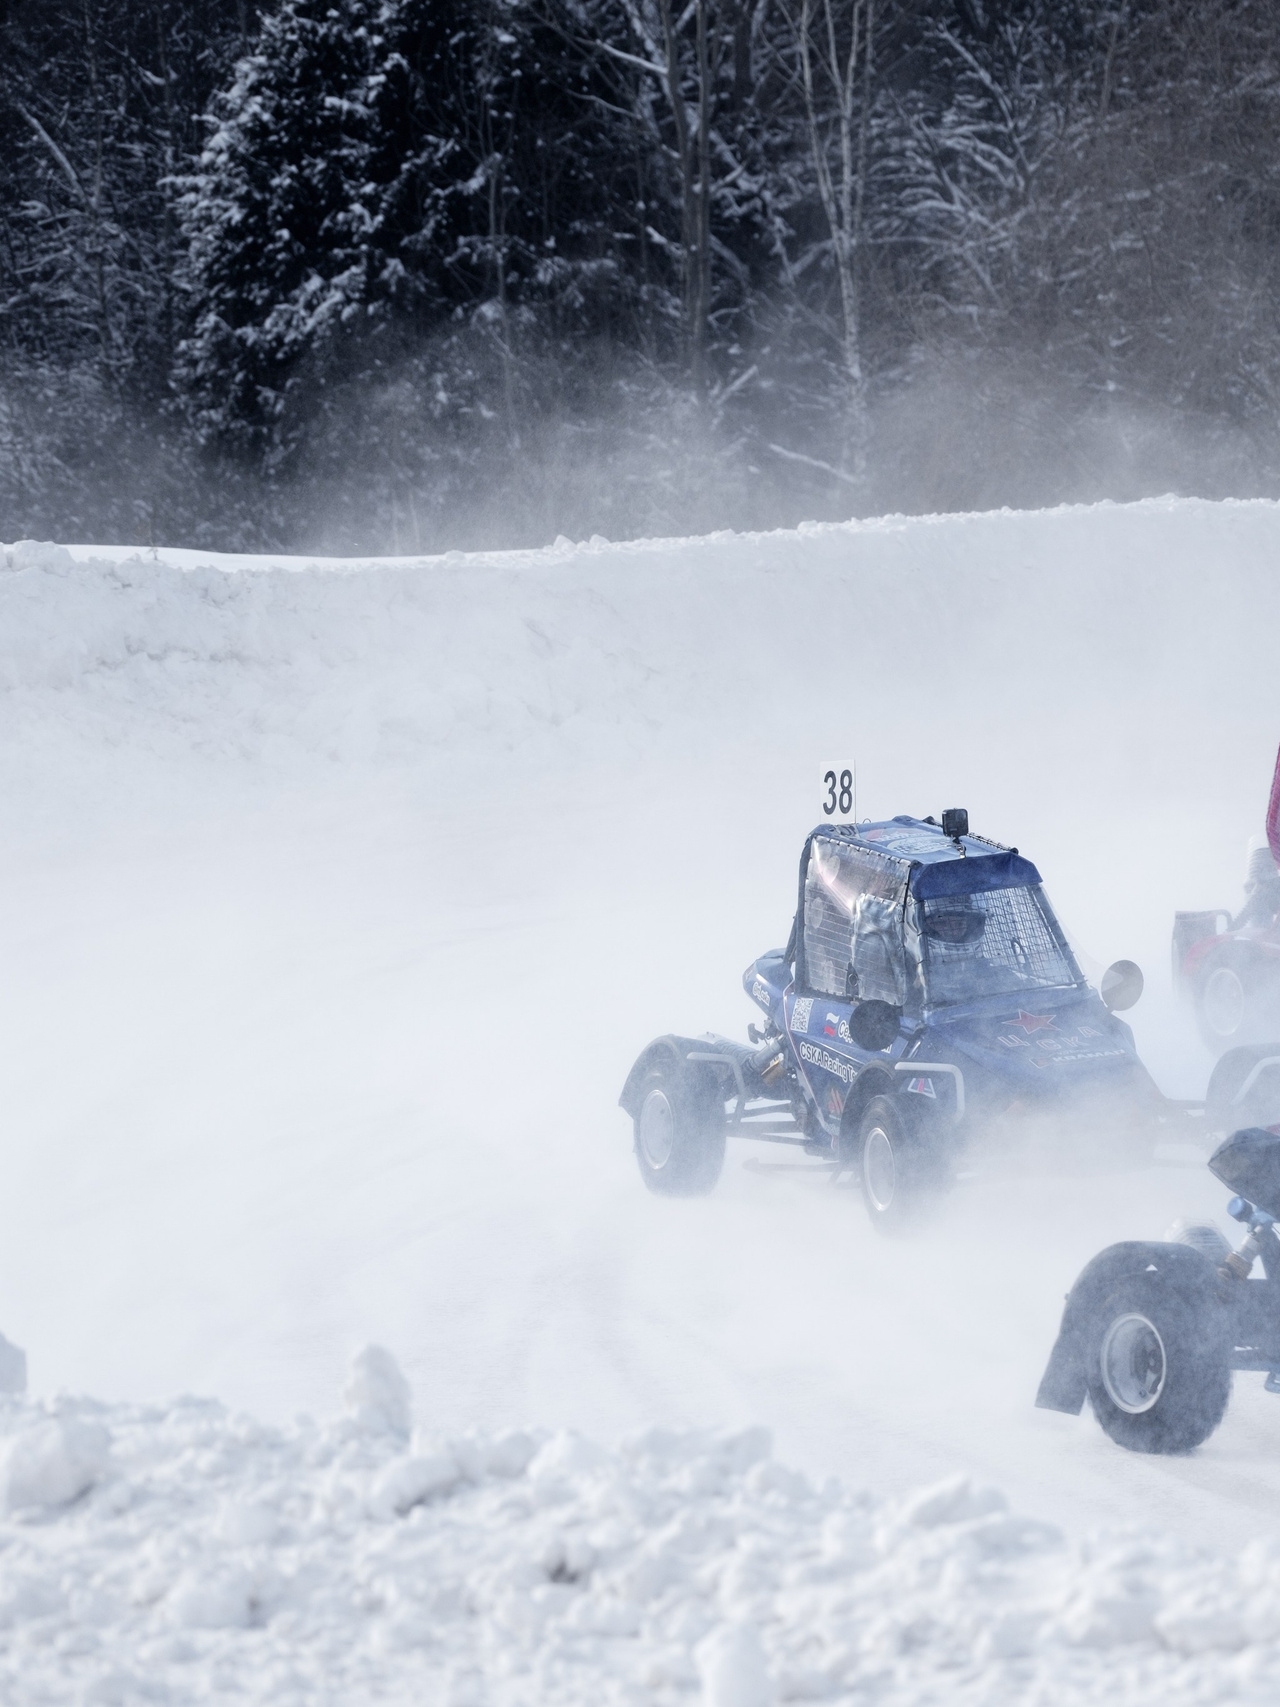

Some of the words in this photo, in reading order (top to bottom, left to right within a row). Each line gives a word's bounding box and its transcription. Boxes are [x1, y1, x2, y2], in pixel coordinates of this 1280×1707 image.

[823, 769, 853, 815] 38
[800, 1042, 822, 1066] CSKA
[822, 1051, 847, 1083] Racing
